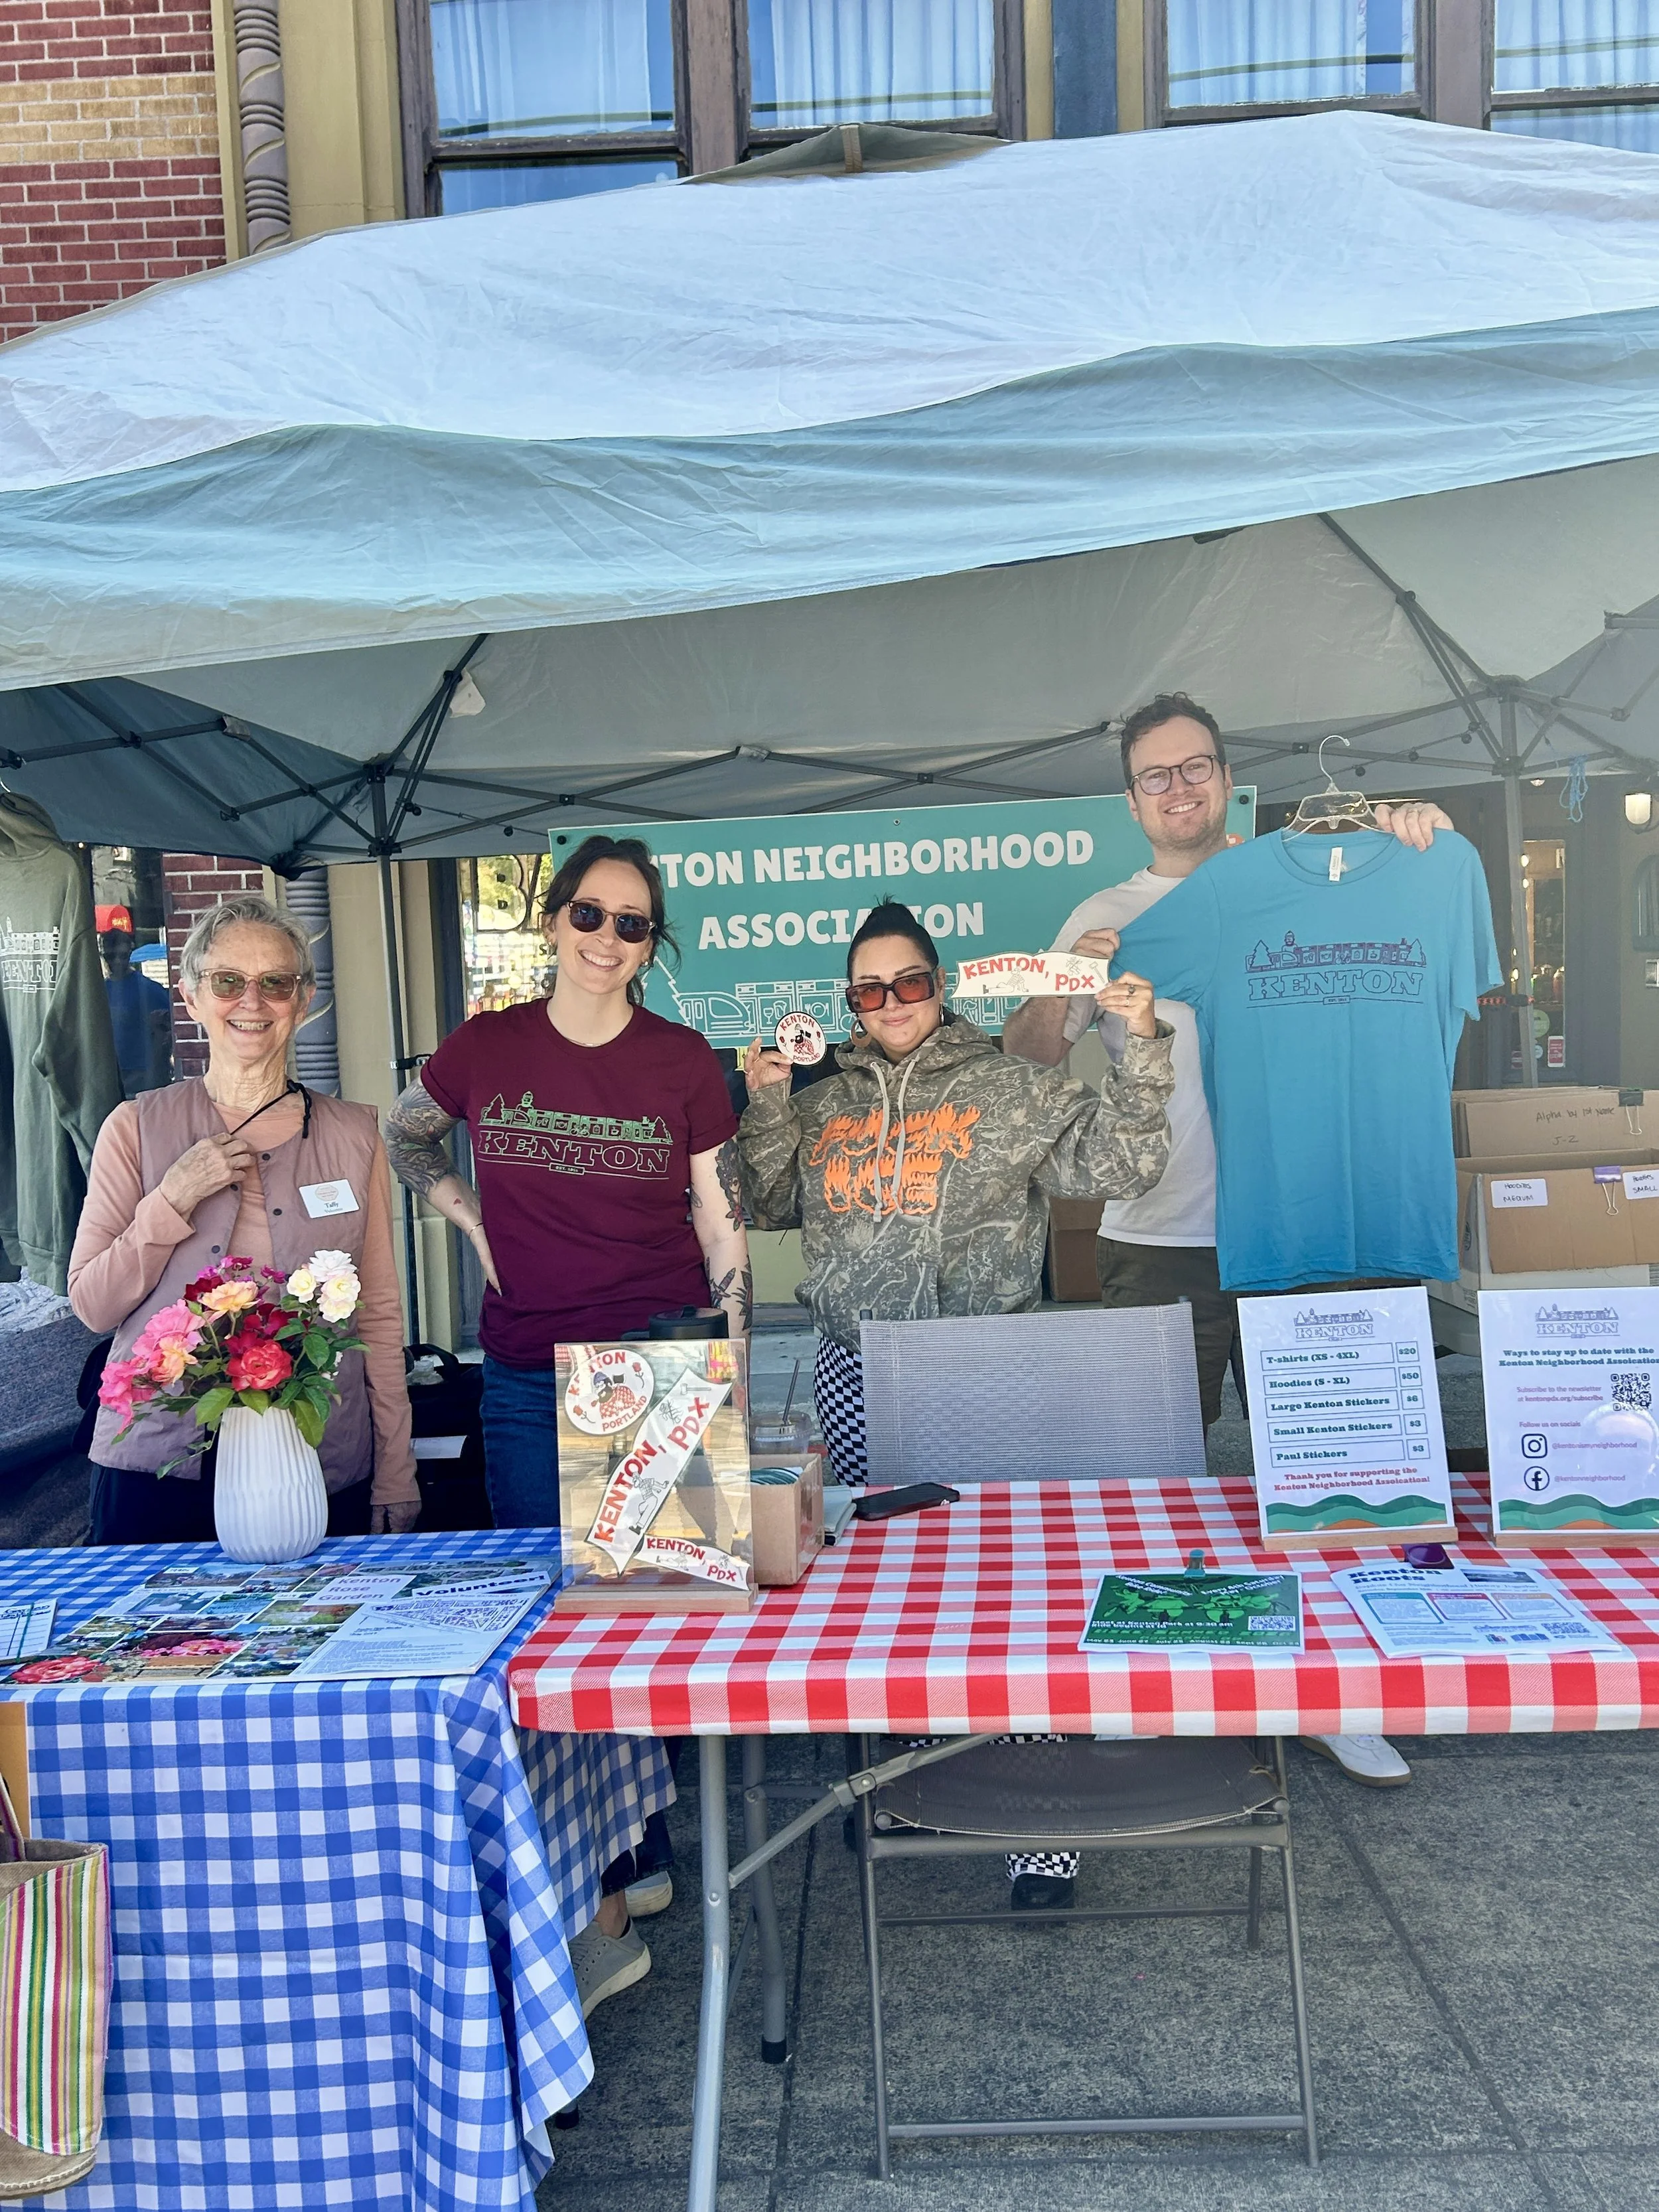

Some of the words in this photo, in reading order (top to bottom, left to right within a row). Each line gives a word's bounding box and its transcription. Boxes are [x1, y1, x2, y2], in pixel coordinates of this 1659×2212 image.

[650, 849, 744, 888] TON
[754, 830, 1094, 883] NEIGHBORHOOD
[699, 902, 984, 950] ASSOCION
[963, 957, 1050, 980] KENTON,
[1055, 973, 1095, 992] PDX
[1248, 969, 1423, 1001] KENTON
[780, 1015, 815, 1031] KENTON
[793, 1053, 821, 1063] PORTLAND
[1536, 1112, 1561, 1123] Alpha
[1567, 1110, 1577, 1118] by
[478, 1130, 670, 1173] KENTON
[1632, 1185, 1658, 1194] SMALL
[1295, 1323, 1373, 1339] KENTON
[1537, 1322, 1619, 1334] KENTON
[1311, 1353, 1328, 1362] (XS
[1536, 1358, 1605, 1367] Neighborhood
[1269, 1379, 1312, 1388] Hoodies
[1314, 1378, 1325, 1386] (S
[1271, 1403, 1302, 1412] Large
[1303, 1400, 1344, 1409] Kenton
[1345, 1398, 1390, 1406] Stickers
[602, 1395, 647, 1432] PORTLAND
[1306, 1424, 1346, 1434] Kenton
[1303, 1450, 1347, 1459] Stickers
[594, 1439, 667, 1543] KENTON,
[668, 1396, 710, 1451] PDX
[1349, 1468, 1400, 1478] supporting
[1309, 1479, 1373, 1489] Neighborhood
[707, 1564, 736, 1582] PDX
[1347, 1568, 1442, 1578] Kenton
[1351, 1575, 1425, 1584] Roots
[415, 1575, 545, 1596] Volunteer!
